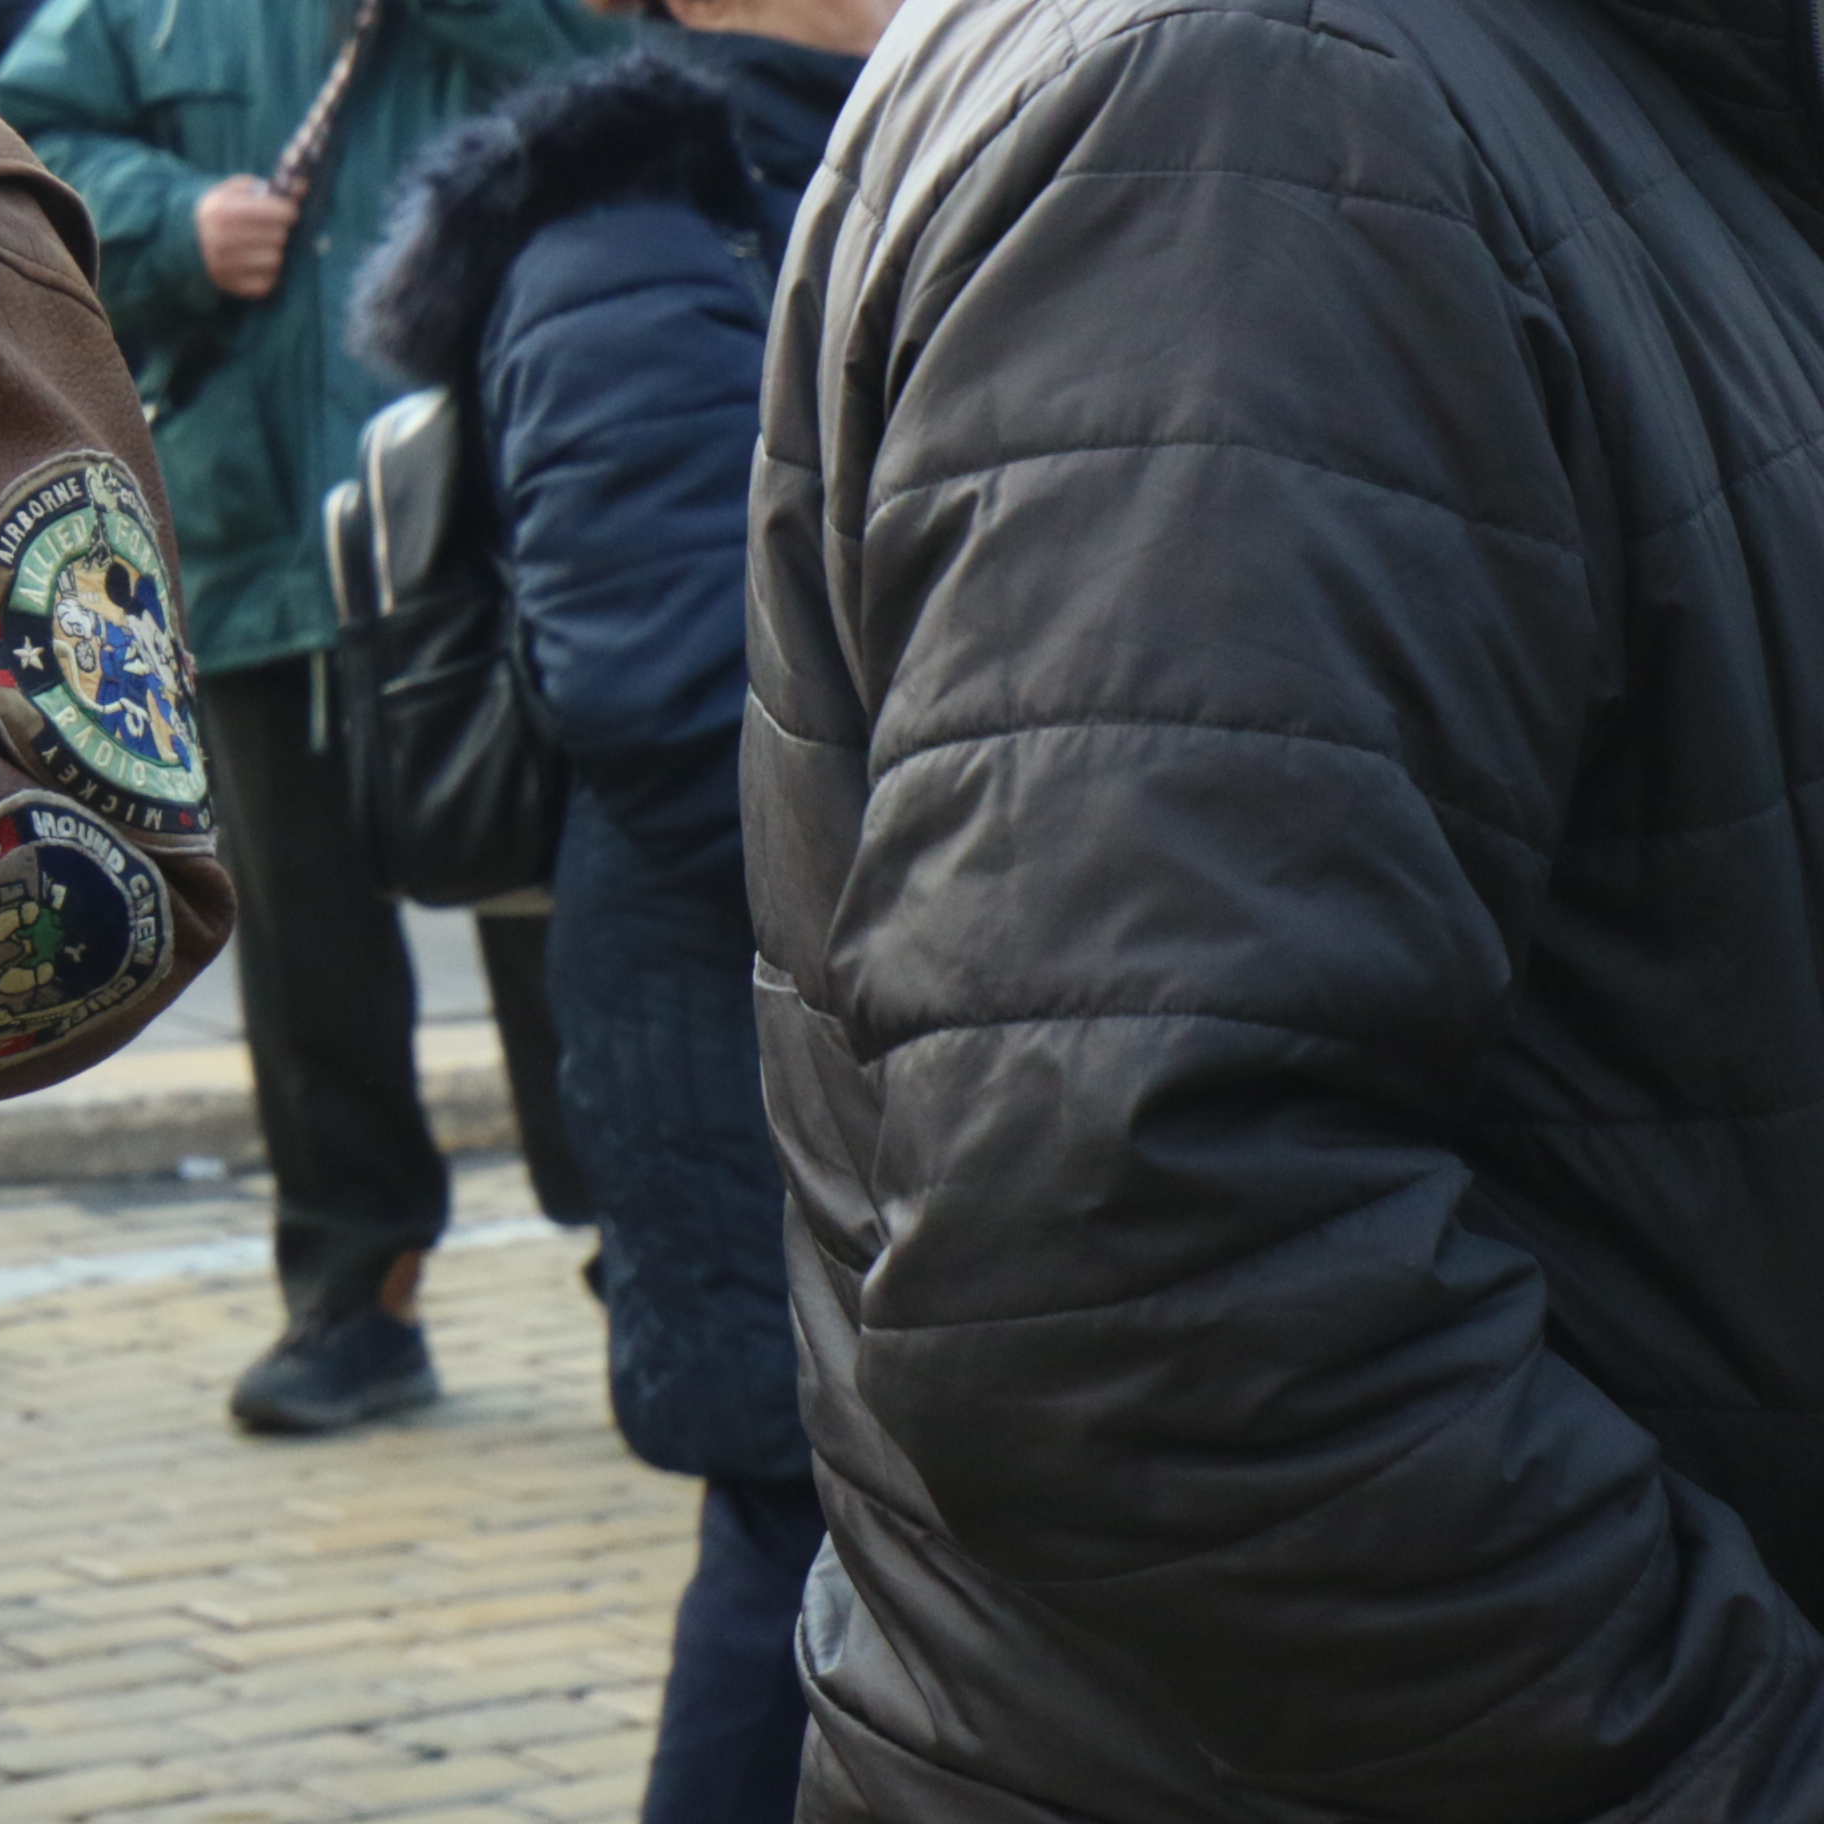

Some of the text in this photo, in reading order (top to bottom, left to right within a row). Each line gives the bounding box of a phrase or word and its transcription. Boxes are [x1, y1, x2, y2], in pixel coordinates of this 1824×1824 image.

[18, 514, 88, 607] ALLIED
[41, 743, 163, 831] MICKEY
[53, 706, 146, 788] RADIO
